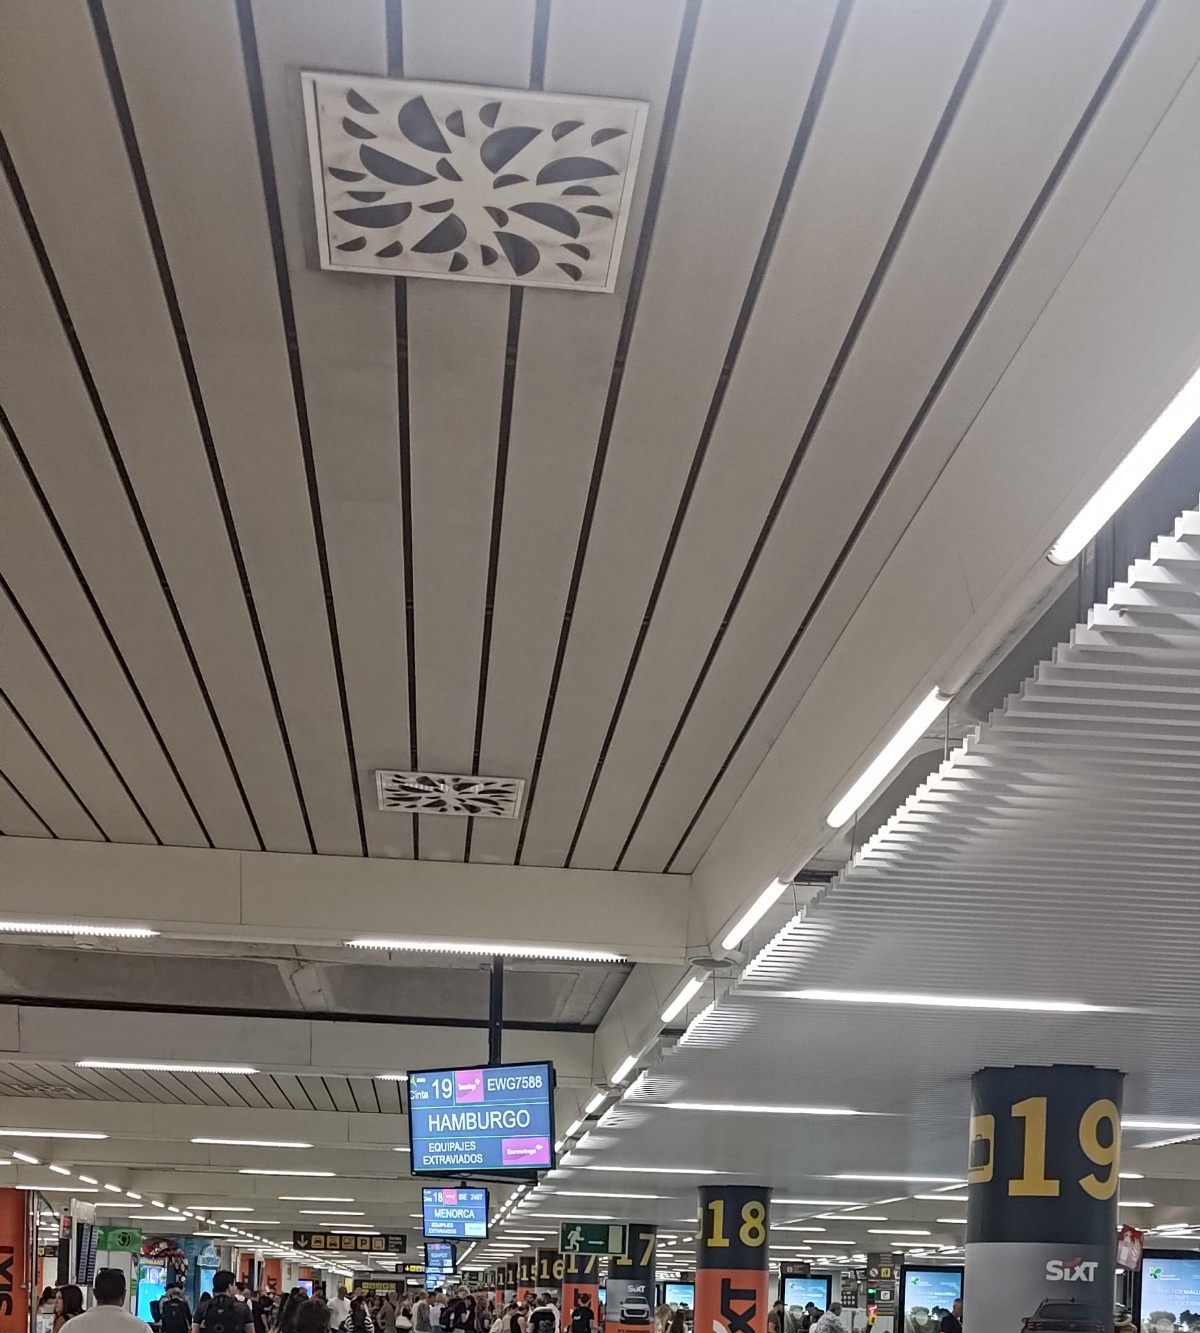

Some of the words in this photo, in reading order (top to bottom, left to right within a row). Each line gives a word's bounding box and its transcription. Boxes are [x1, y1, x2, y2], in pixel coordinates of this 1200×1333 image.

[431, 1078, 453, 1100] 19
[487, 1075, 543, 1092] EWG7588
[428, 1109, 531, 1132] HAMBURGO
[428, 1140, 477, 1153] EQUIPAJES
[1008, 1096, 1120, 1201] 19
[423, 1153, 484, 1166] EXTRAVIADOS
[434, 1208, 476, 1219] MENORCA
[707, 1199, 766, 1247] 18
[540, 1258, 564, 1280] 16
[1045, 1258, 1099, 1282] SIXT
